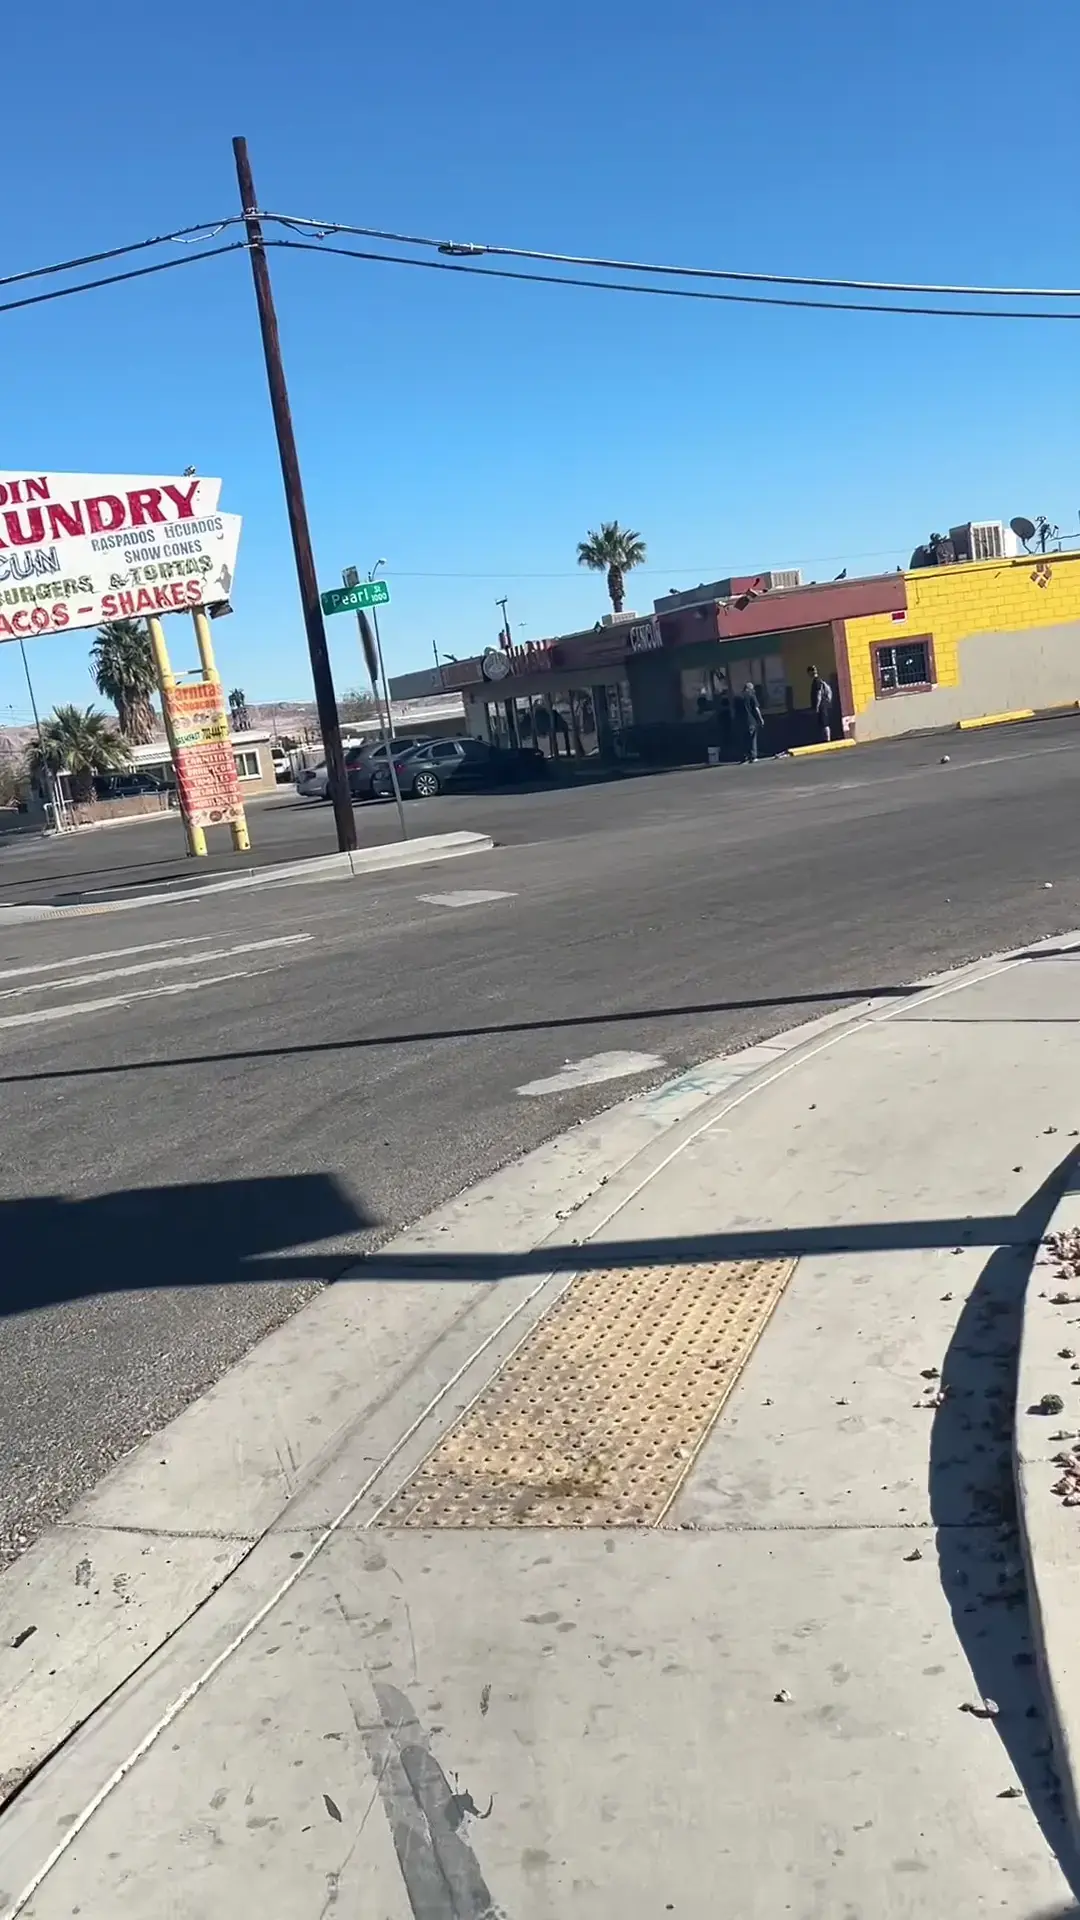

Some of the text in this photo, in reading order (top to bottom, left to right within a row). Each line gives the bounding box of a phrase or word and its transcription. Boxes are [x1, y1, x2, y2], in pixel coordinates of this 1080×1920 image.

[91, 517, 223, 552] RASPADOS LICUADOS
[124, 539, 203, 564] SNOW CONES
[108, 572, 128, 590] &
[129, 554, 213, 582] TORTAS
[101, 579, 202, 616] SHAKES
[333, 589, 368, 607] Pearl
[371, 592, 386, 602] 1000
[184, 752, 231, 765] CARNITAS
